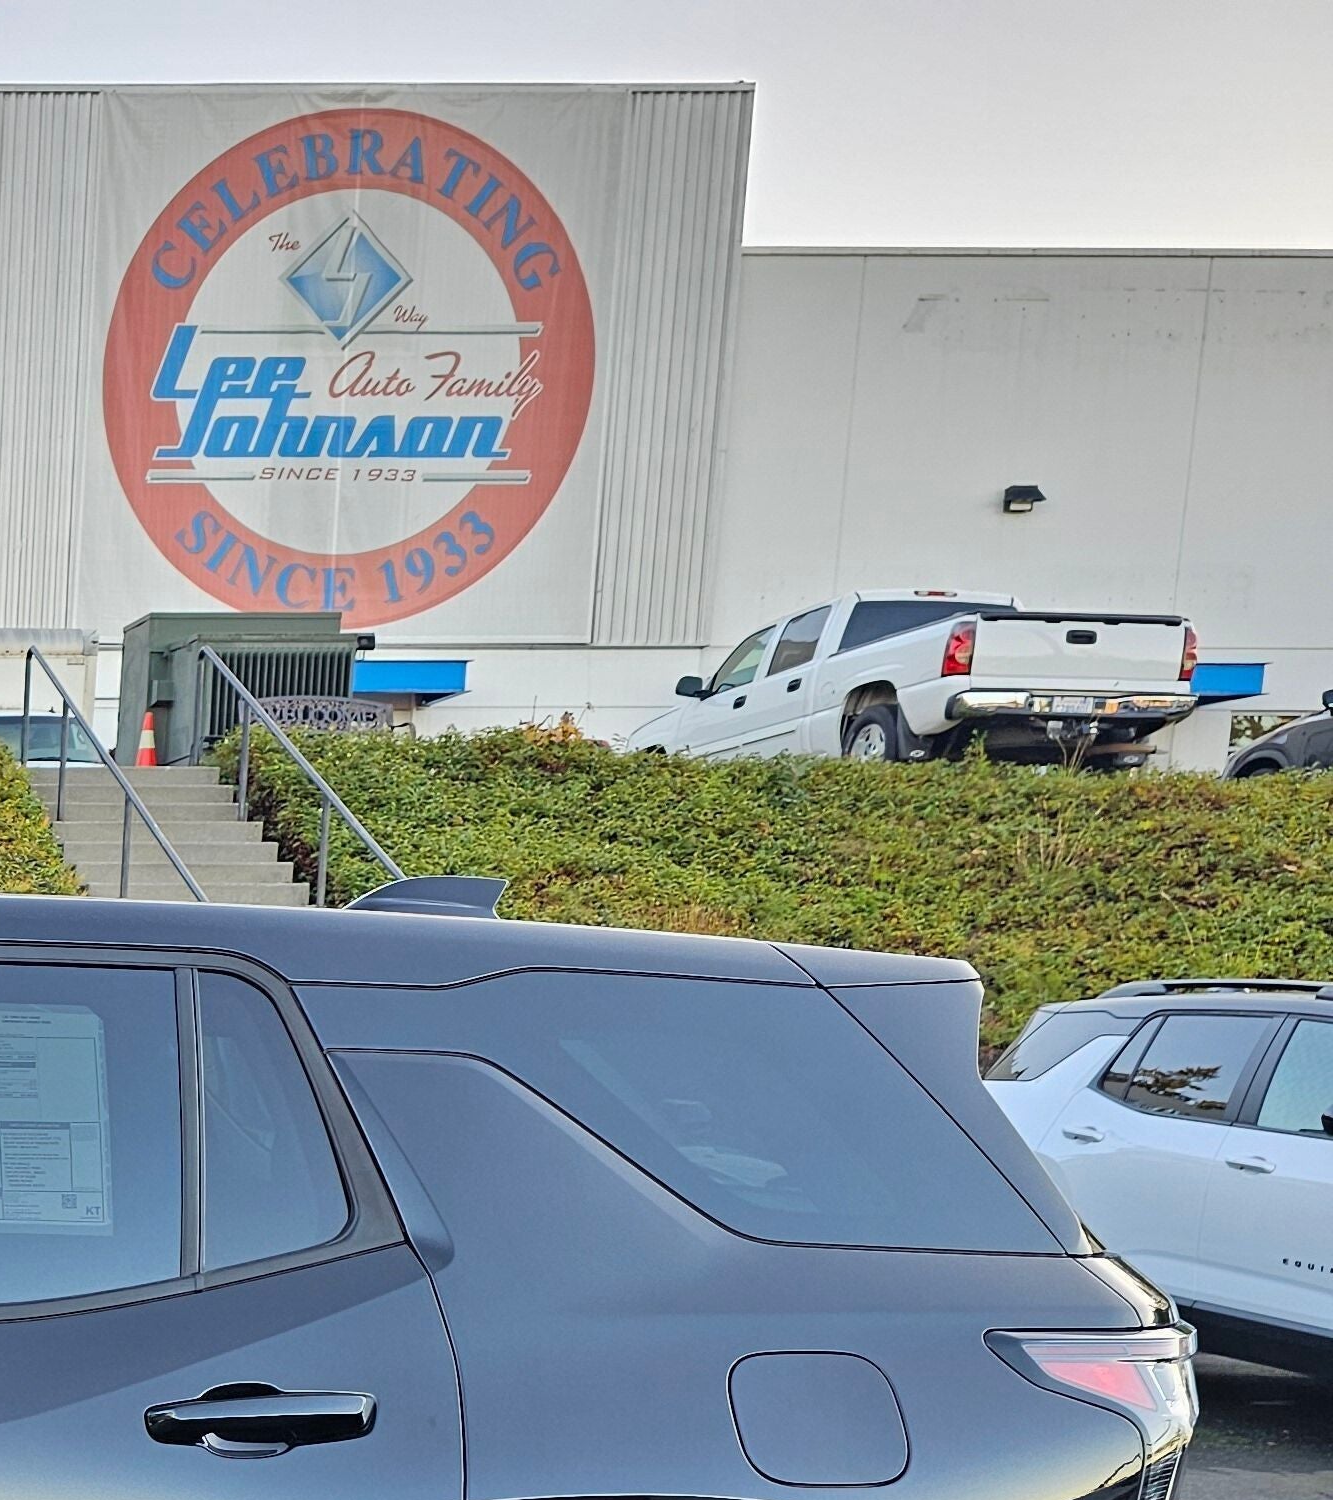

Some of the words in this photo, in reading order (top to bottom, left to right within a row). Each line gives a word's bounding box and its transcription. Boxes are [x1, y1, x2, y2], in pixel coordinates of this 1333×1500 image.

[151, 127, 561, 292] CELEBRATING
[268, 232, 301, 253] The
[393, 304, 430, 331] Way
[152, 325, 311, 400] Lee
[328, 351, 416, 400] Auto
[423, 350, 541, 420] Family
[155, 386, 510, 459] Johnson
[259, 466, 339, 481] SINCE
[351, 468, 418, 483] 1933
[175, 510, 356, 613] SINCE
[381, 509, 496, 606] 1933
[84, 1205, 102, 1216] KT
